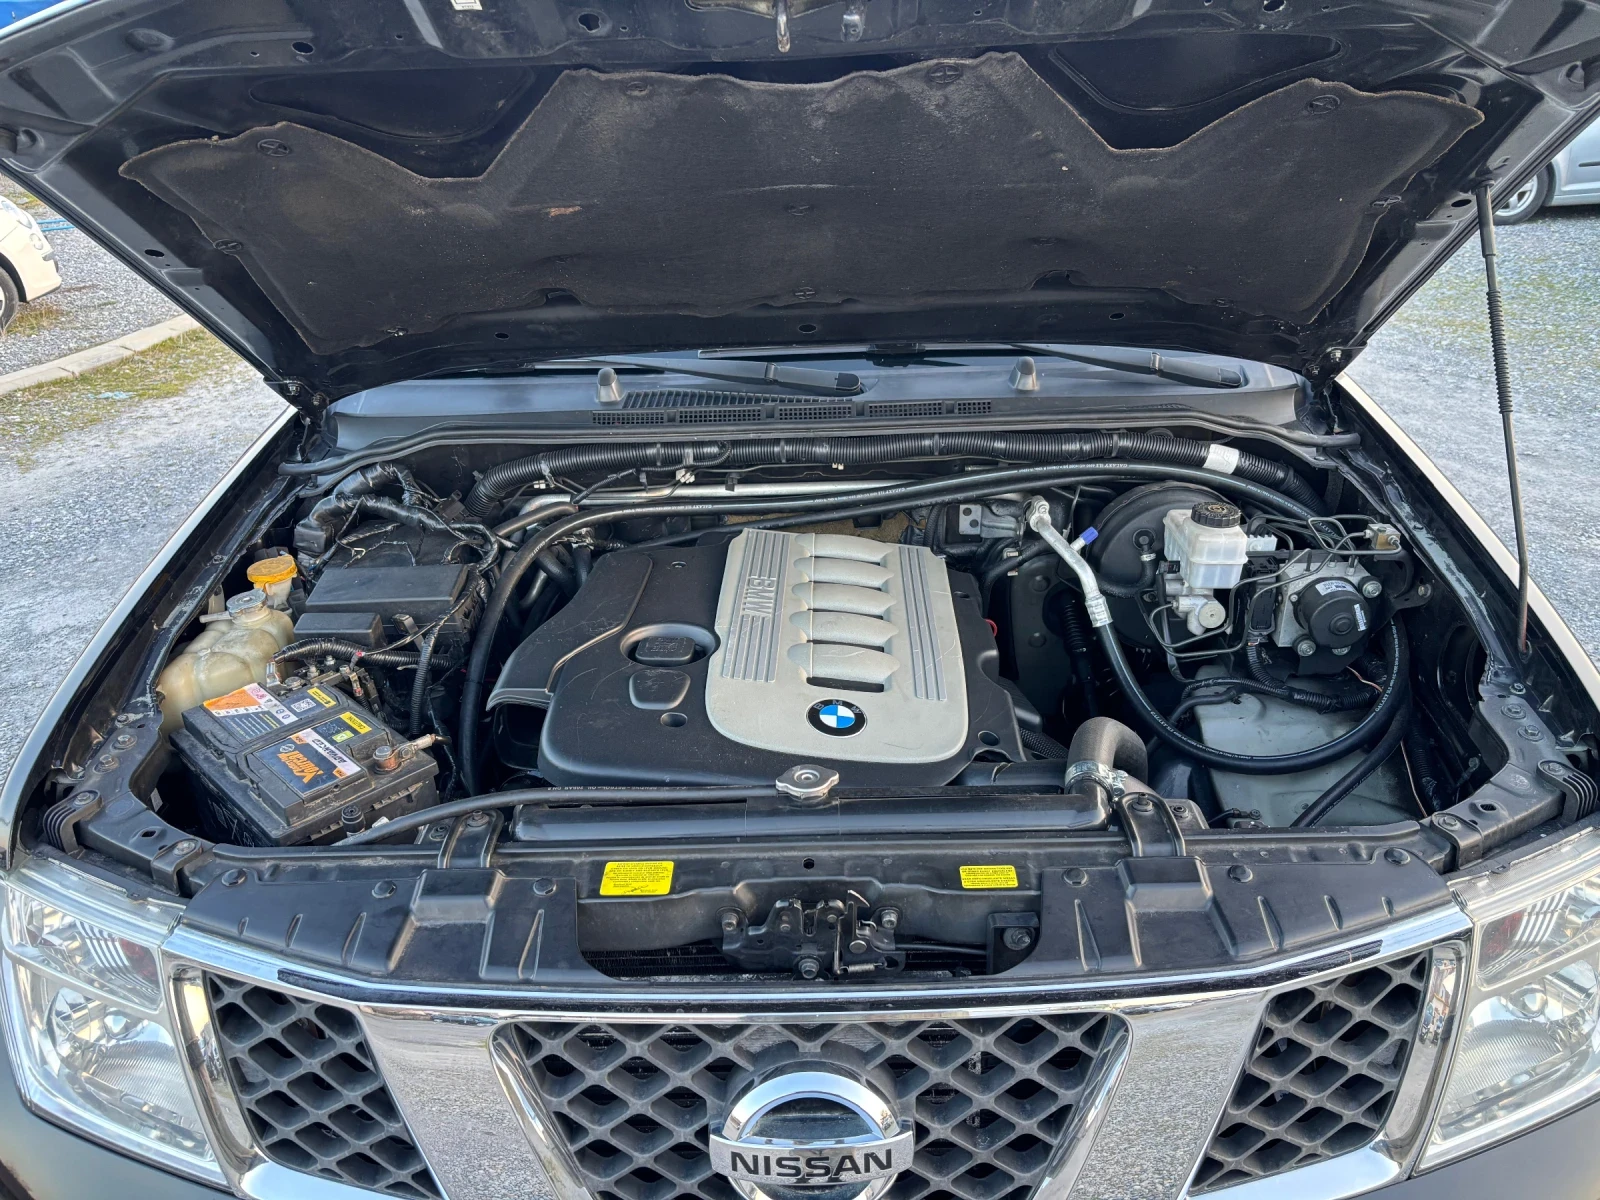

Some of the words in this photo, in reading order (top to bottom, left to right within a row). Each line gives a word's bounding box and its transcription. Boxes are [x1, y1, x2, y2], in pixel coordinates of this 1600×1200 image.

[741, 576, 777, 616] BMW
[813, 699, 862, 714] BMW
[730, 1148, 892, 1177] NISSAN
